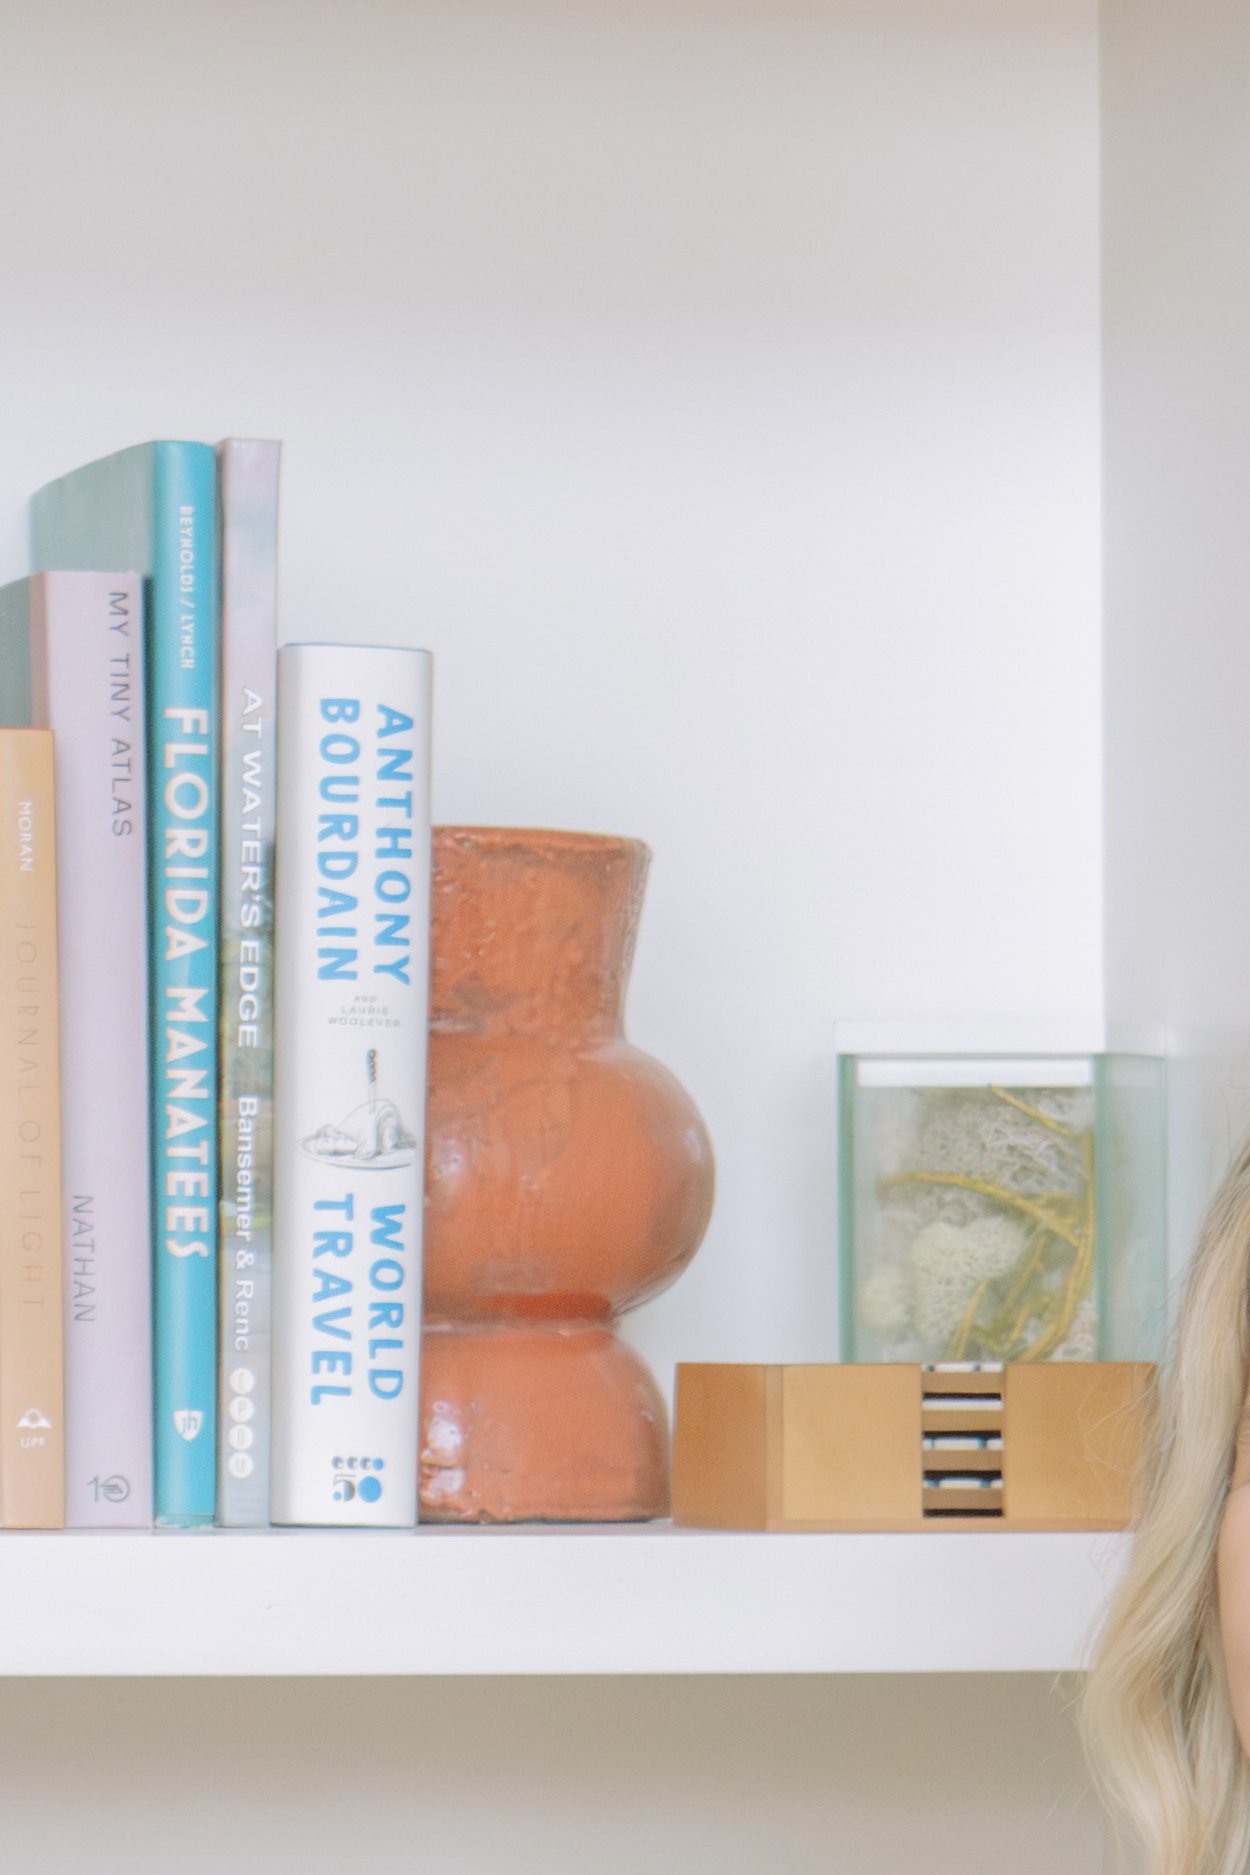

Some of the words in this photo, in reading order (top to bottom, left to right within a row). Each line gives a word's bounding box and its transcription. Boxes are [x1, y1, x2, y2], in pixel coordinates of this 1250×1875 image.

[179, 505, 195, 592] REYNOLDS
[109, 593, 128, 636] MY
[179, 615, 195, 669] LYNCH
[110, 653, 130, 721] TINY
[243, 687, 263, 737] AT
[19, 801, 33, 872] MORAN
[112, 737, 132, 836] ATLAS
[164, 707, 209, 960] FLORIDA
[241, 750, 263, 928] WATER'S
[316, 698, 360, 981] BOURDAIN
[372, 703, 414, 985] ANTHONY
[16, 924, 40, 1100] JOURNAL
[238, 940, 260, 1049] EDGE
[341, 1005, 389, 1015] LAURIE
[19, 1120, 41, 1174] OF
[165, 986, 209, 1258] MANATEES
[236, 1096, 257, 1241] Bansemer
[19, 1189, 44, 1307] LIGHT
[72, 1195, 96, 1322] NATHAN
[235, 1249, 255, 1270] &
[310, 1193, 354, 1406] TRAVEL
[368, 1204, 406, 1400] WORLD
[235, 1279, 254, 1351] Renc
